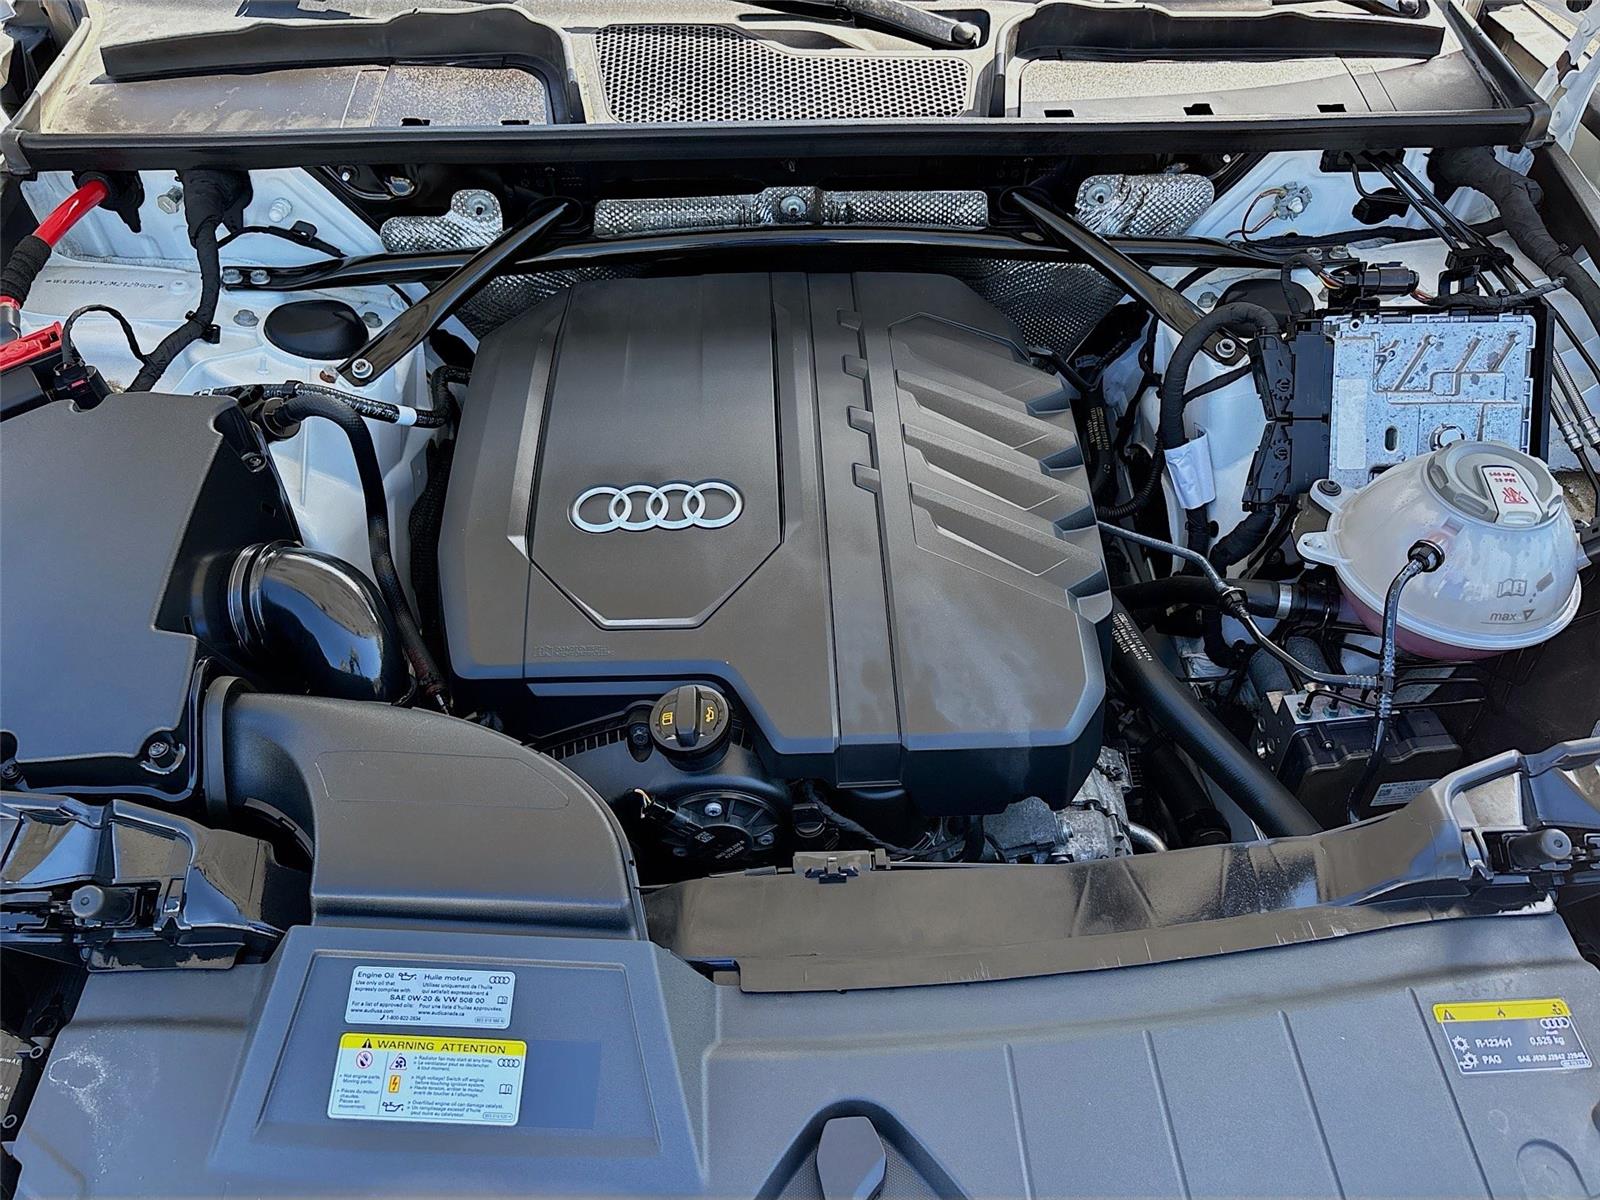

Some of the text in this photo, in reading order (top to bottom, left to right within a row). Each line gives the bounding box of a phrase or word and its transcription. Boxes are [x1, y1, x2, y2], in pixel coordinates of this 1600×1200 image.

[1554, 1036, 1565, 1046] kg
[378, 1040, 506, 1054] WARNING ATTENTION
[1481, 1055, 1502, 1065] PAG
